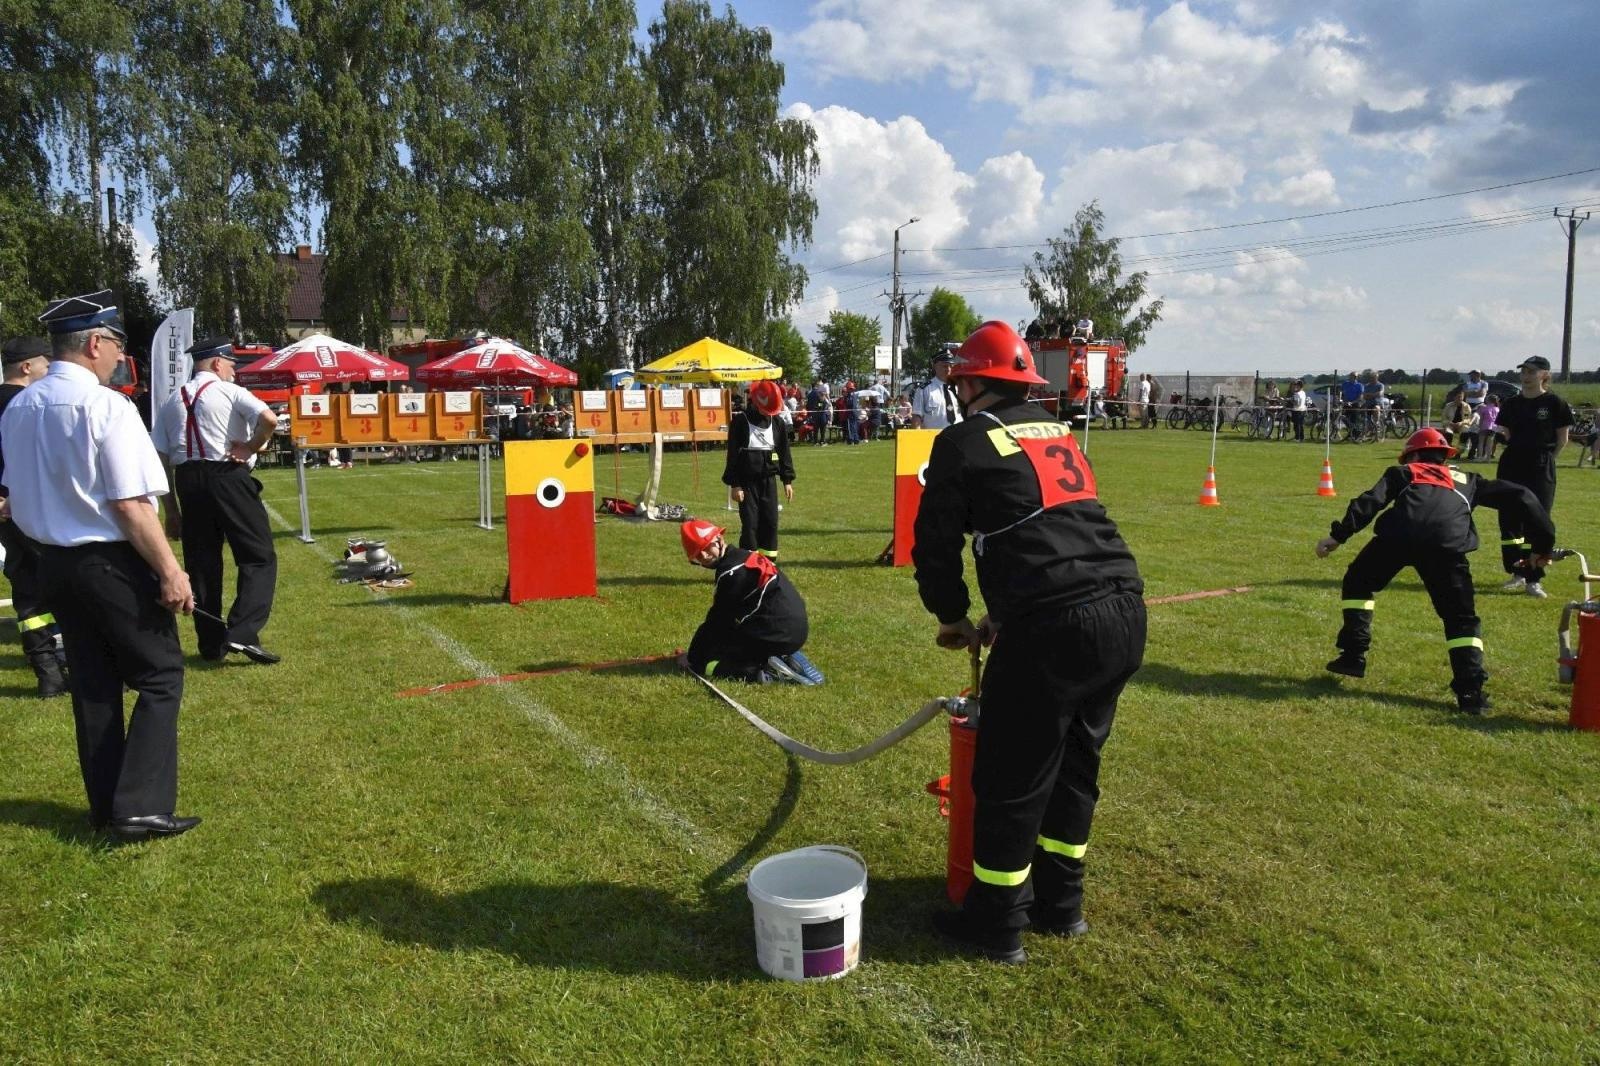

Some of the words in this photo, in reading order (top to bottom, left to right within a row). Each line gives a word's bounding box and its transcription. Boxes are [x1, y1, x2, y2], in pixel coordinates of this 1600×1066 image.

[408, 417, 418, 432] 4
[454, 416, 465, 432] 5
[591, 412, 601, 427] 6
[632, 412, 640, 426] 7
[670, 411, 680, 425] 8
[707, 410, 717, 424] 9
[311, 420, 322, 435] 2
[360, 418, 372, 434] 3
[1045, 445, 1085, 492] 3
